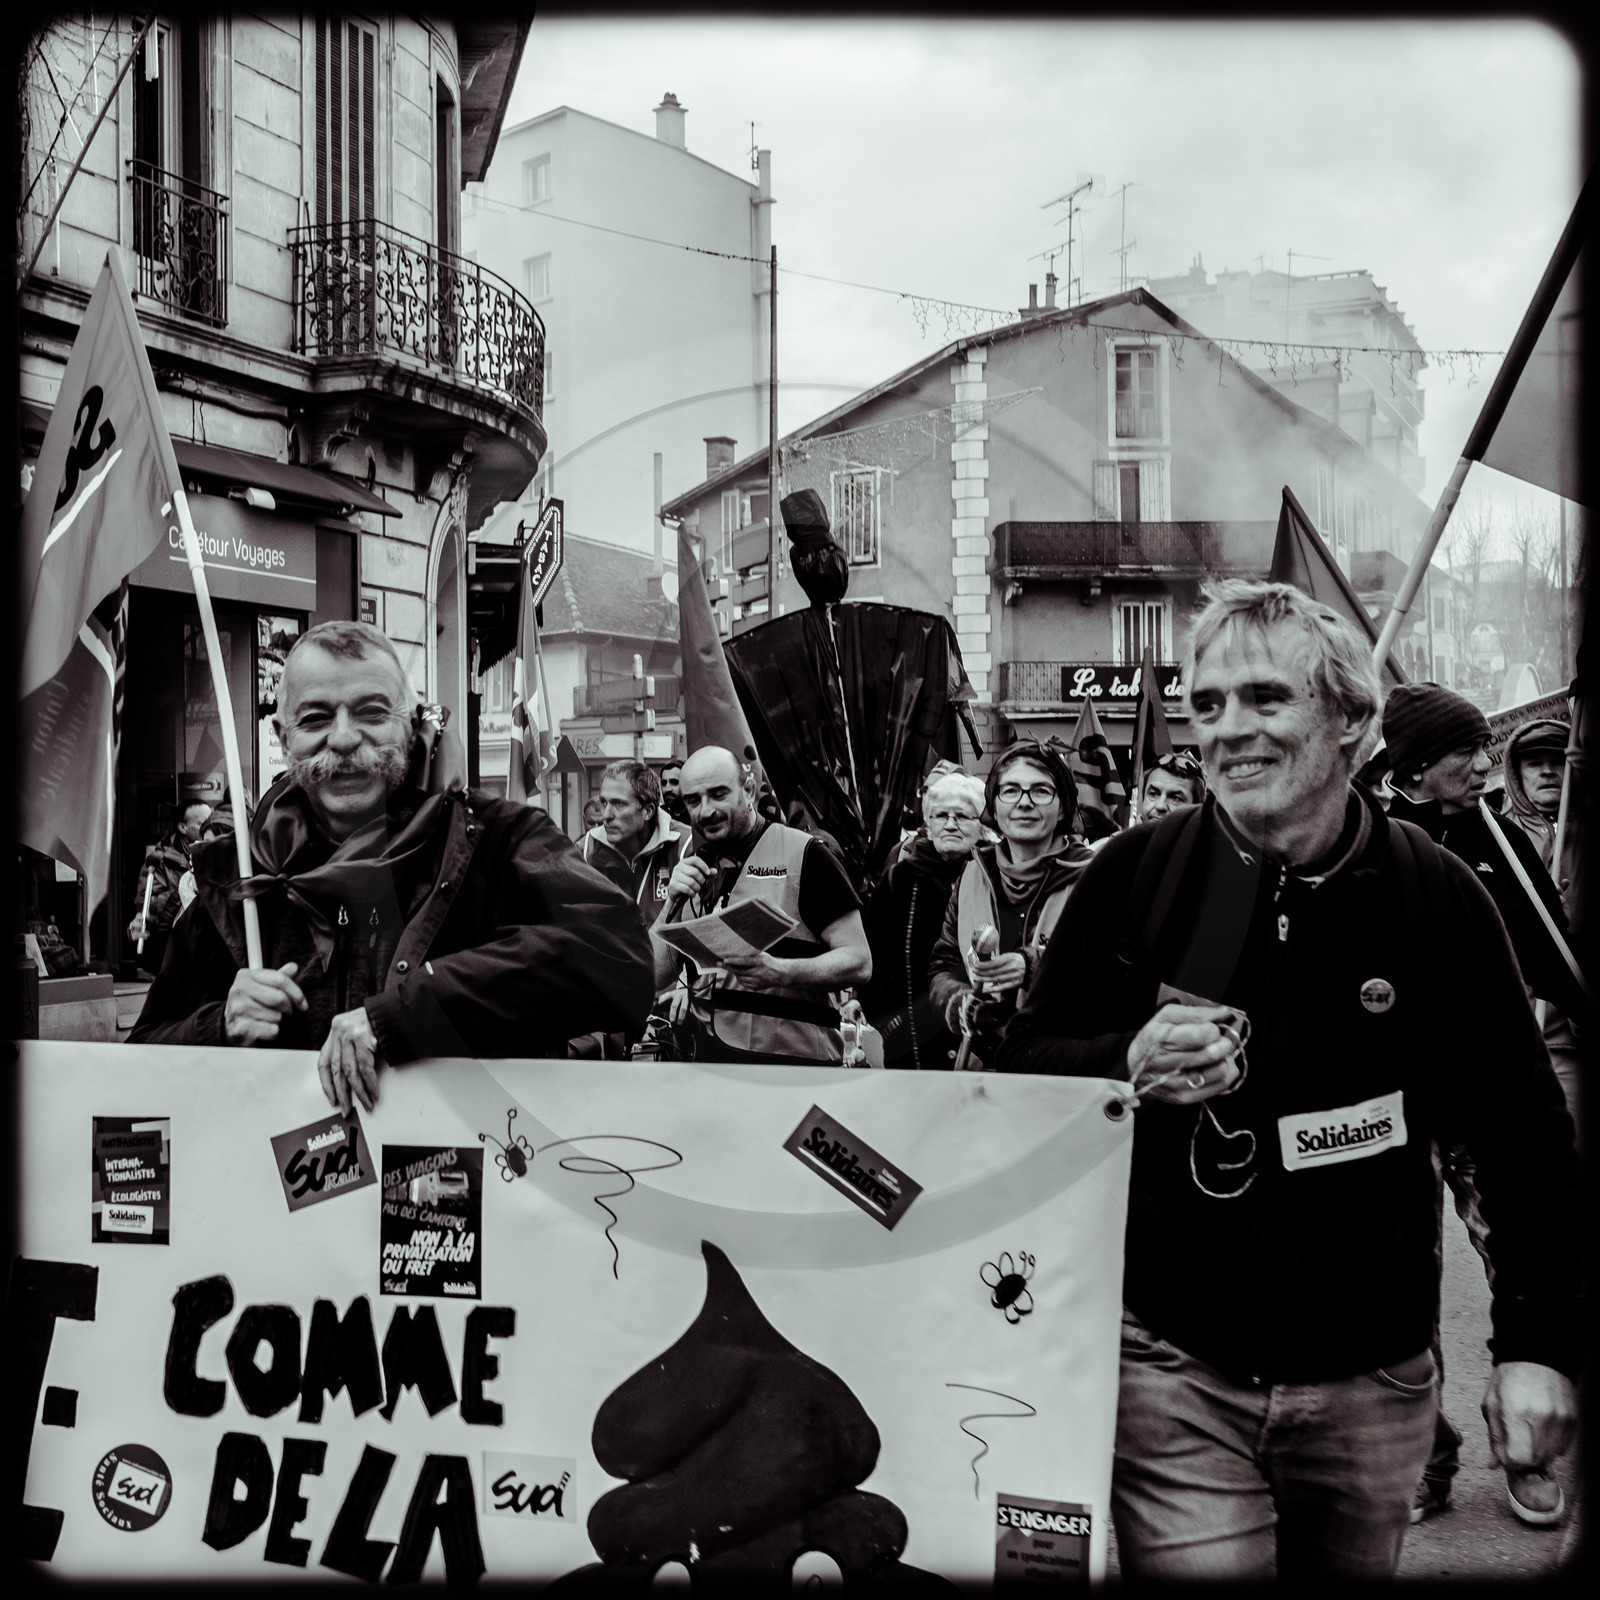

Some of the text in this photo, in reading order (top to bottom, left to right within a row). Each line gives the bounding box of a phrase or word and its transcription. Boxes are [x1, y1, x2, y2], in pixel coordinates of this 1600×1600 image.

[169, 525, 285, 569] Caétour Voyages
[532, 529, 553, 586] TABAC
[1069, 668, 1103, 697] La
[1109, 667, 1142, 697] tab
[747, 864, 788, 876] Solidaires
[307, 1129, 346, 1152] Solidaires
[1296, 1117, 1392, 1154] Solidaires
[284, 1126, 365, 1200] Sud
[323, 1163, 361, 1193] Rail
[383, 1147, 458, 1189] DES WAGONS
[802, 1126, 898, 1211] Solidaires
[109, 1209, 146, 1222] Solidaires
[382, 1202, 467, 1232] PAS DES CAMIONS
[382, 1242, 475, 1262] PRIVATISATION
[409, 1229, 475, 1248] NON À LA
[382, 1258, 436, 1277] DU FRET
[163, 1272, 518, 1428] COMME
[95, 1451, 132, 1529] Santé Sociaux
[117, 1476, 159, 1506] Sud
[491, 1470, 571, 1518] Sud
[998, 1506, 1091, 1536] S'ENGAGER
